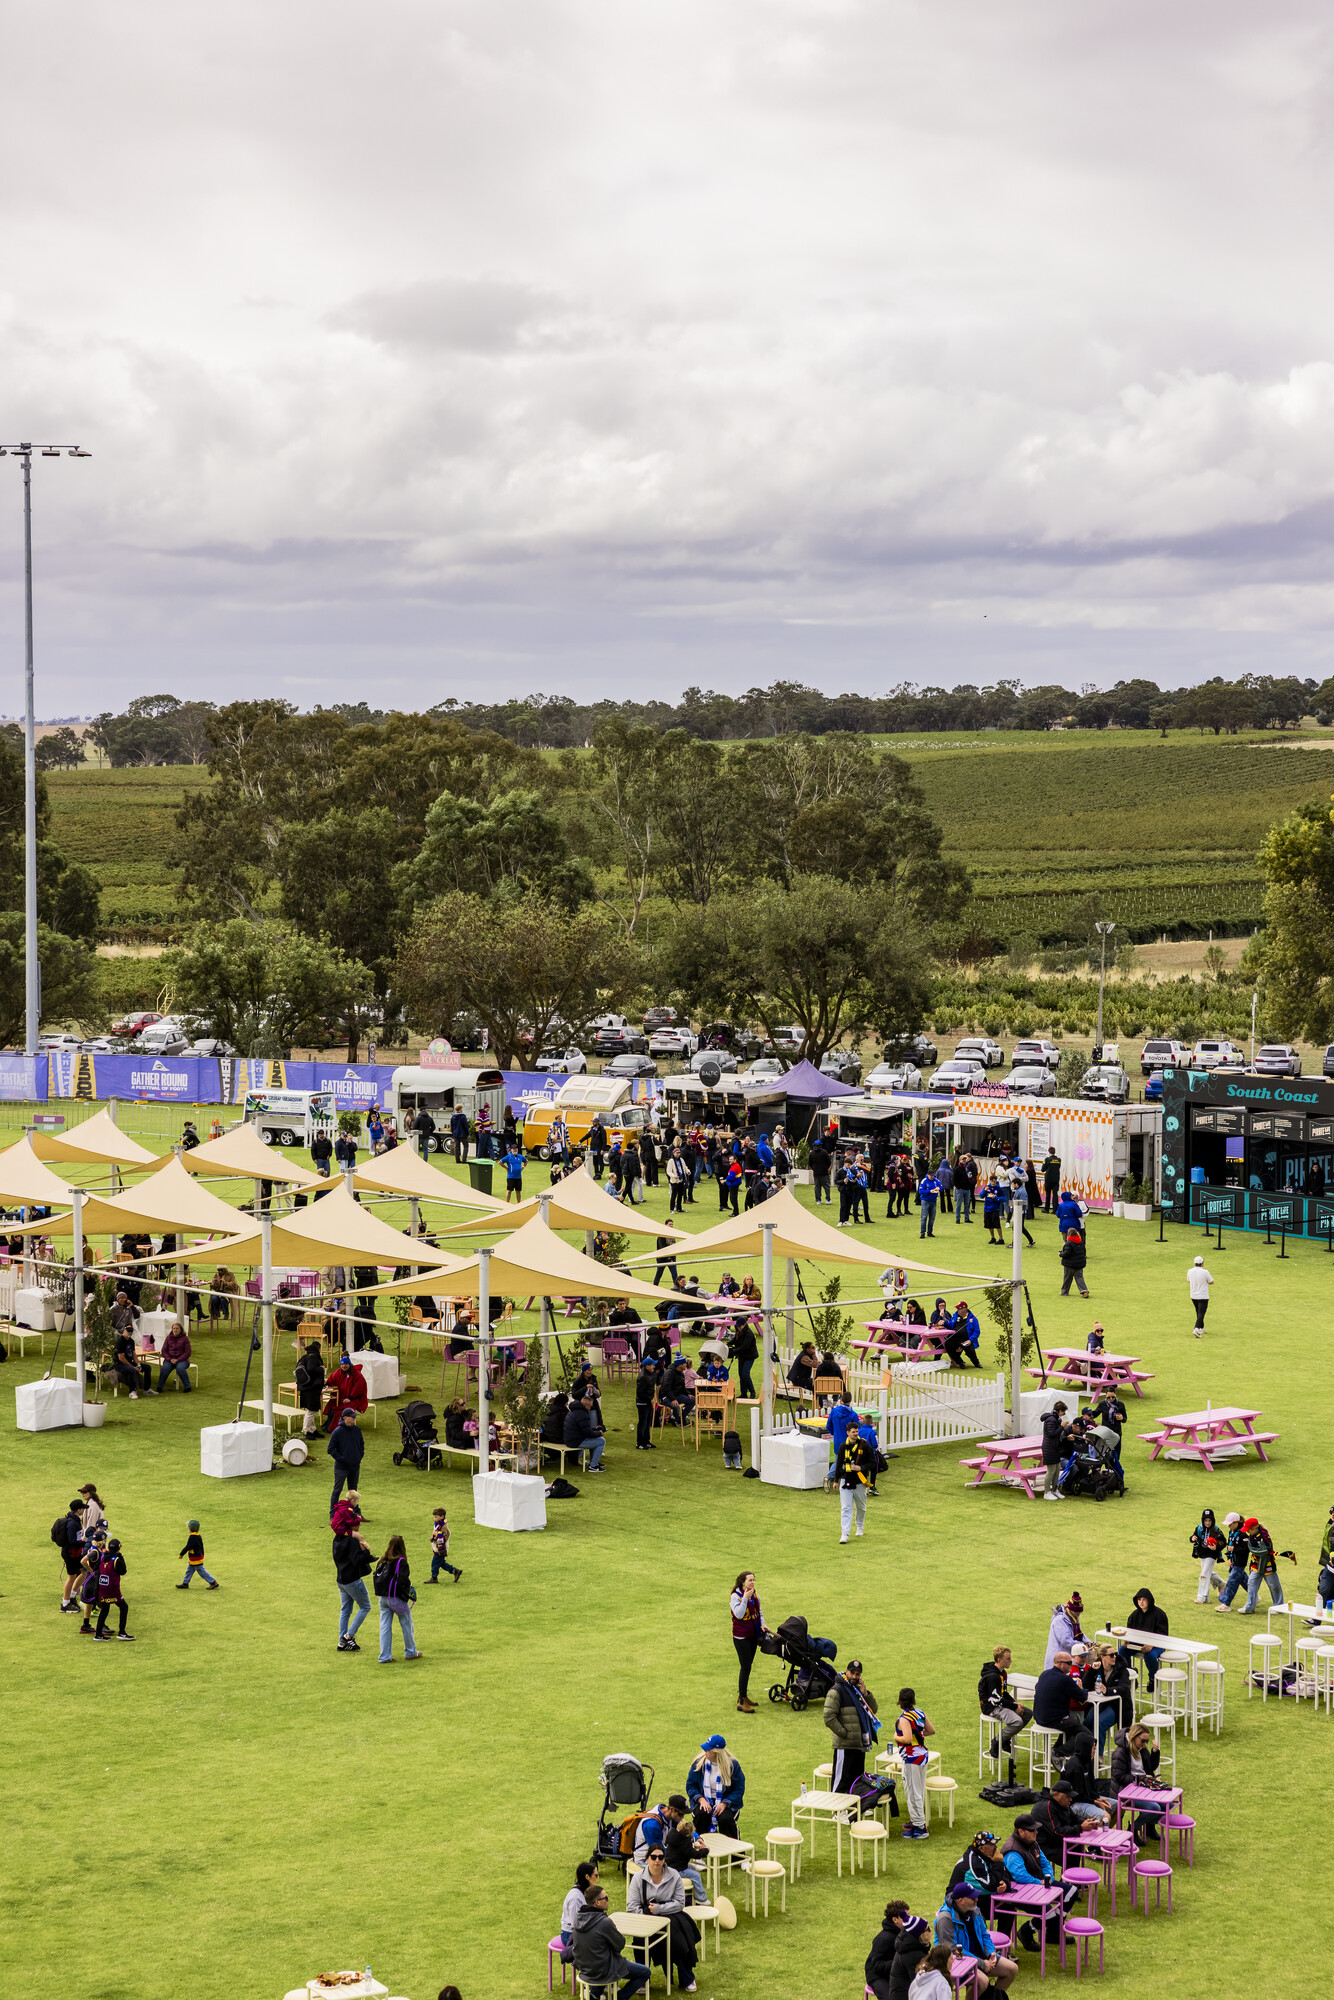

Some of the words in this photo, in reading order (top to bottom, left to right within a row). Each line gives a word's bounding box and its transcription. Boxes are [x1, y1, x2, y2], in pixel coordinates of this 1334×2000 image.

[436, 1056, 459, 1064] CREAM
[131, 1071, 160, 1087] GATHER
[161, 1072, 188, 1087] ROUND
[321, 1079, 352, 1095] GATHER
[353, 1081, 378, 1096] ROUND
[1226, 1084, 1273, 1100] South
[1274, 1088, 1320, 1104] Coast
